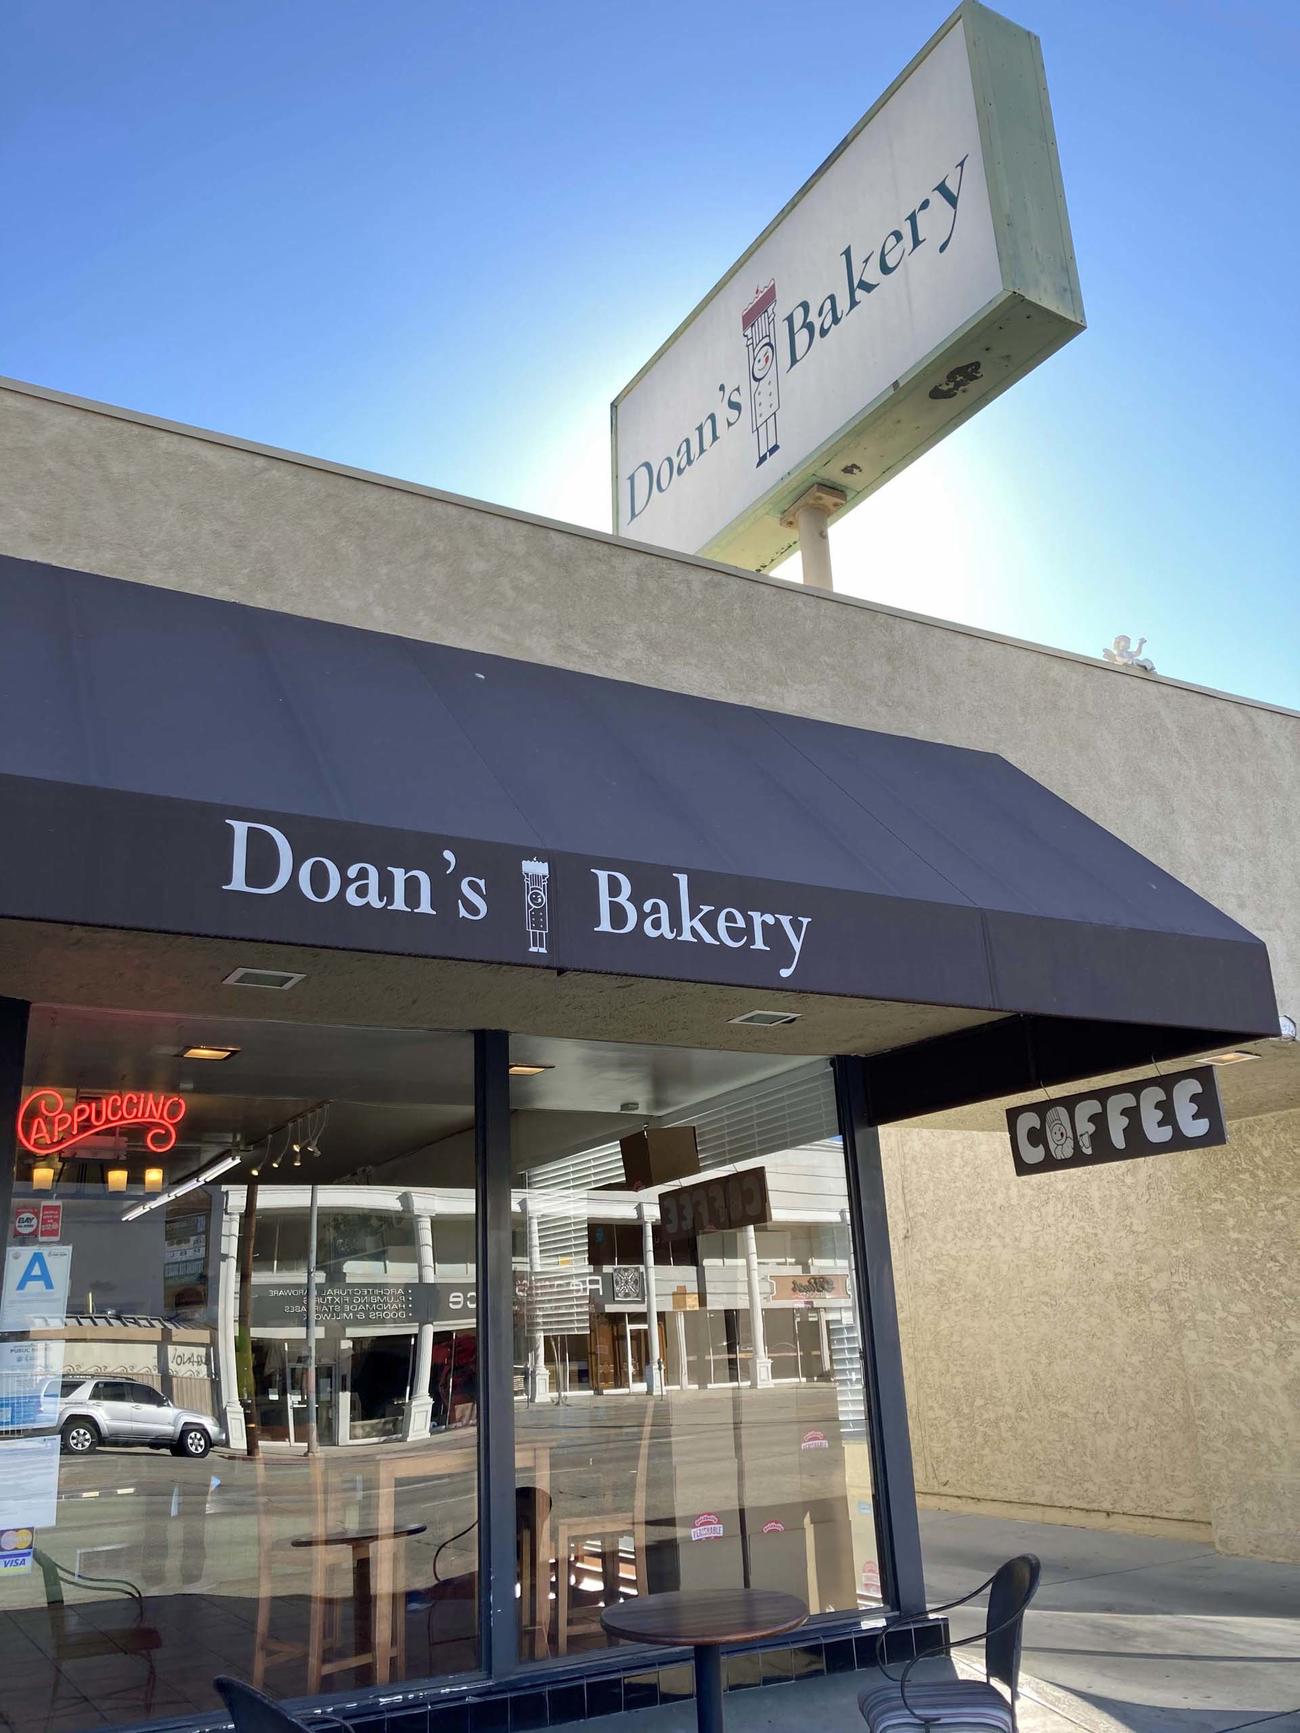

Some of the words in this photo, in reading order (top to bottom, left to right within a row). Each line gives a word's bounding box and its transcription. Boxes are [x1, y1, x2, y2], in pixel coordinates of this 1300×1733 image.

[627, 383, 743, 526] Doan's
[782, 153, 969, 374] Bakery
[221, 819, 488, 921] Doan's
[590, 868, 812, 978] Bakery
[17, 1088, 186, 1154] CAPPUCCINO
[1016, 1078, 1210, 1165] COFFEE
[16, 1251, 55, 1291] A
[4, 1558, 26, 1568] VISA
